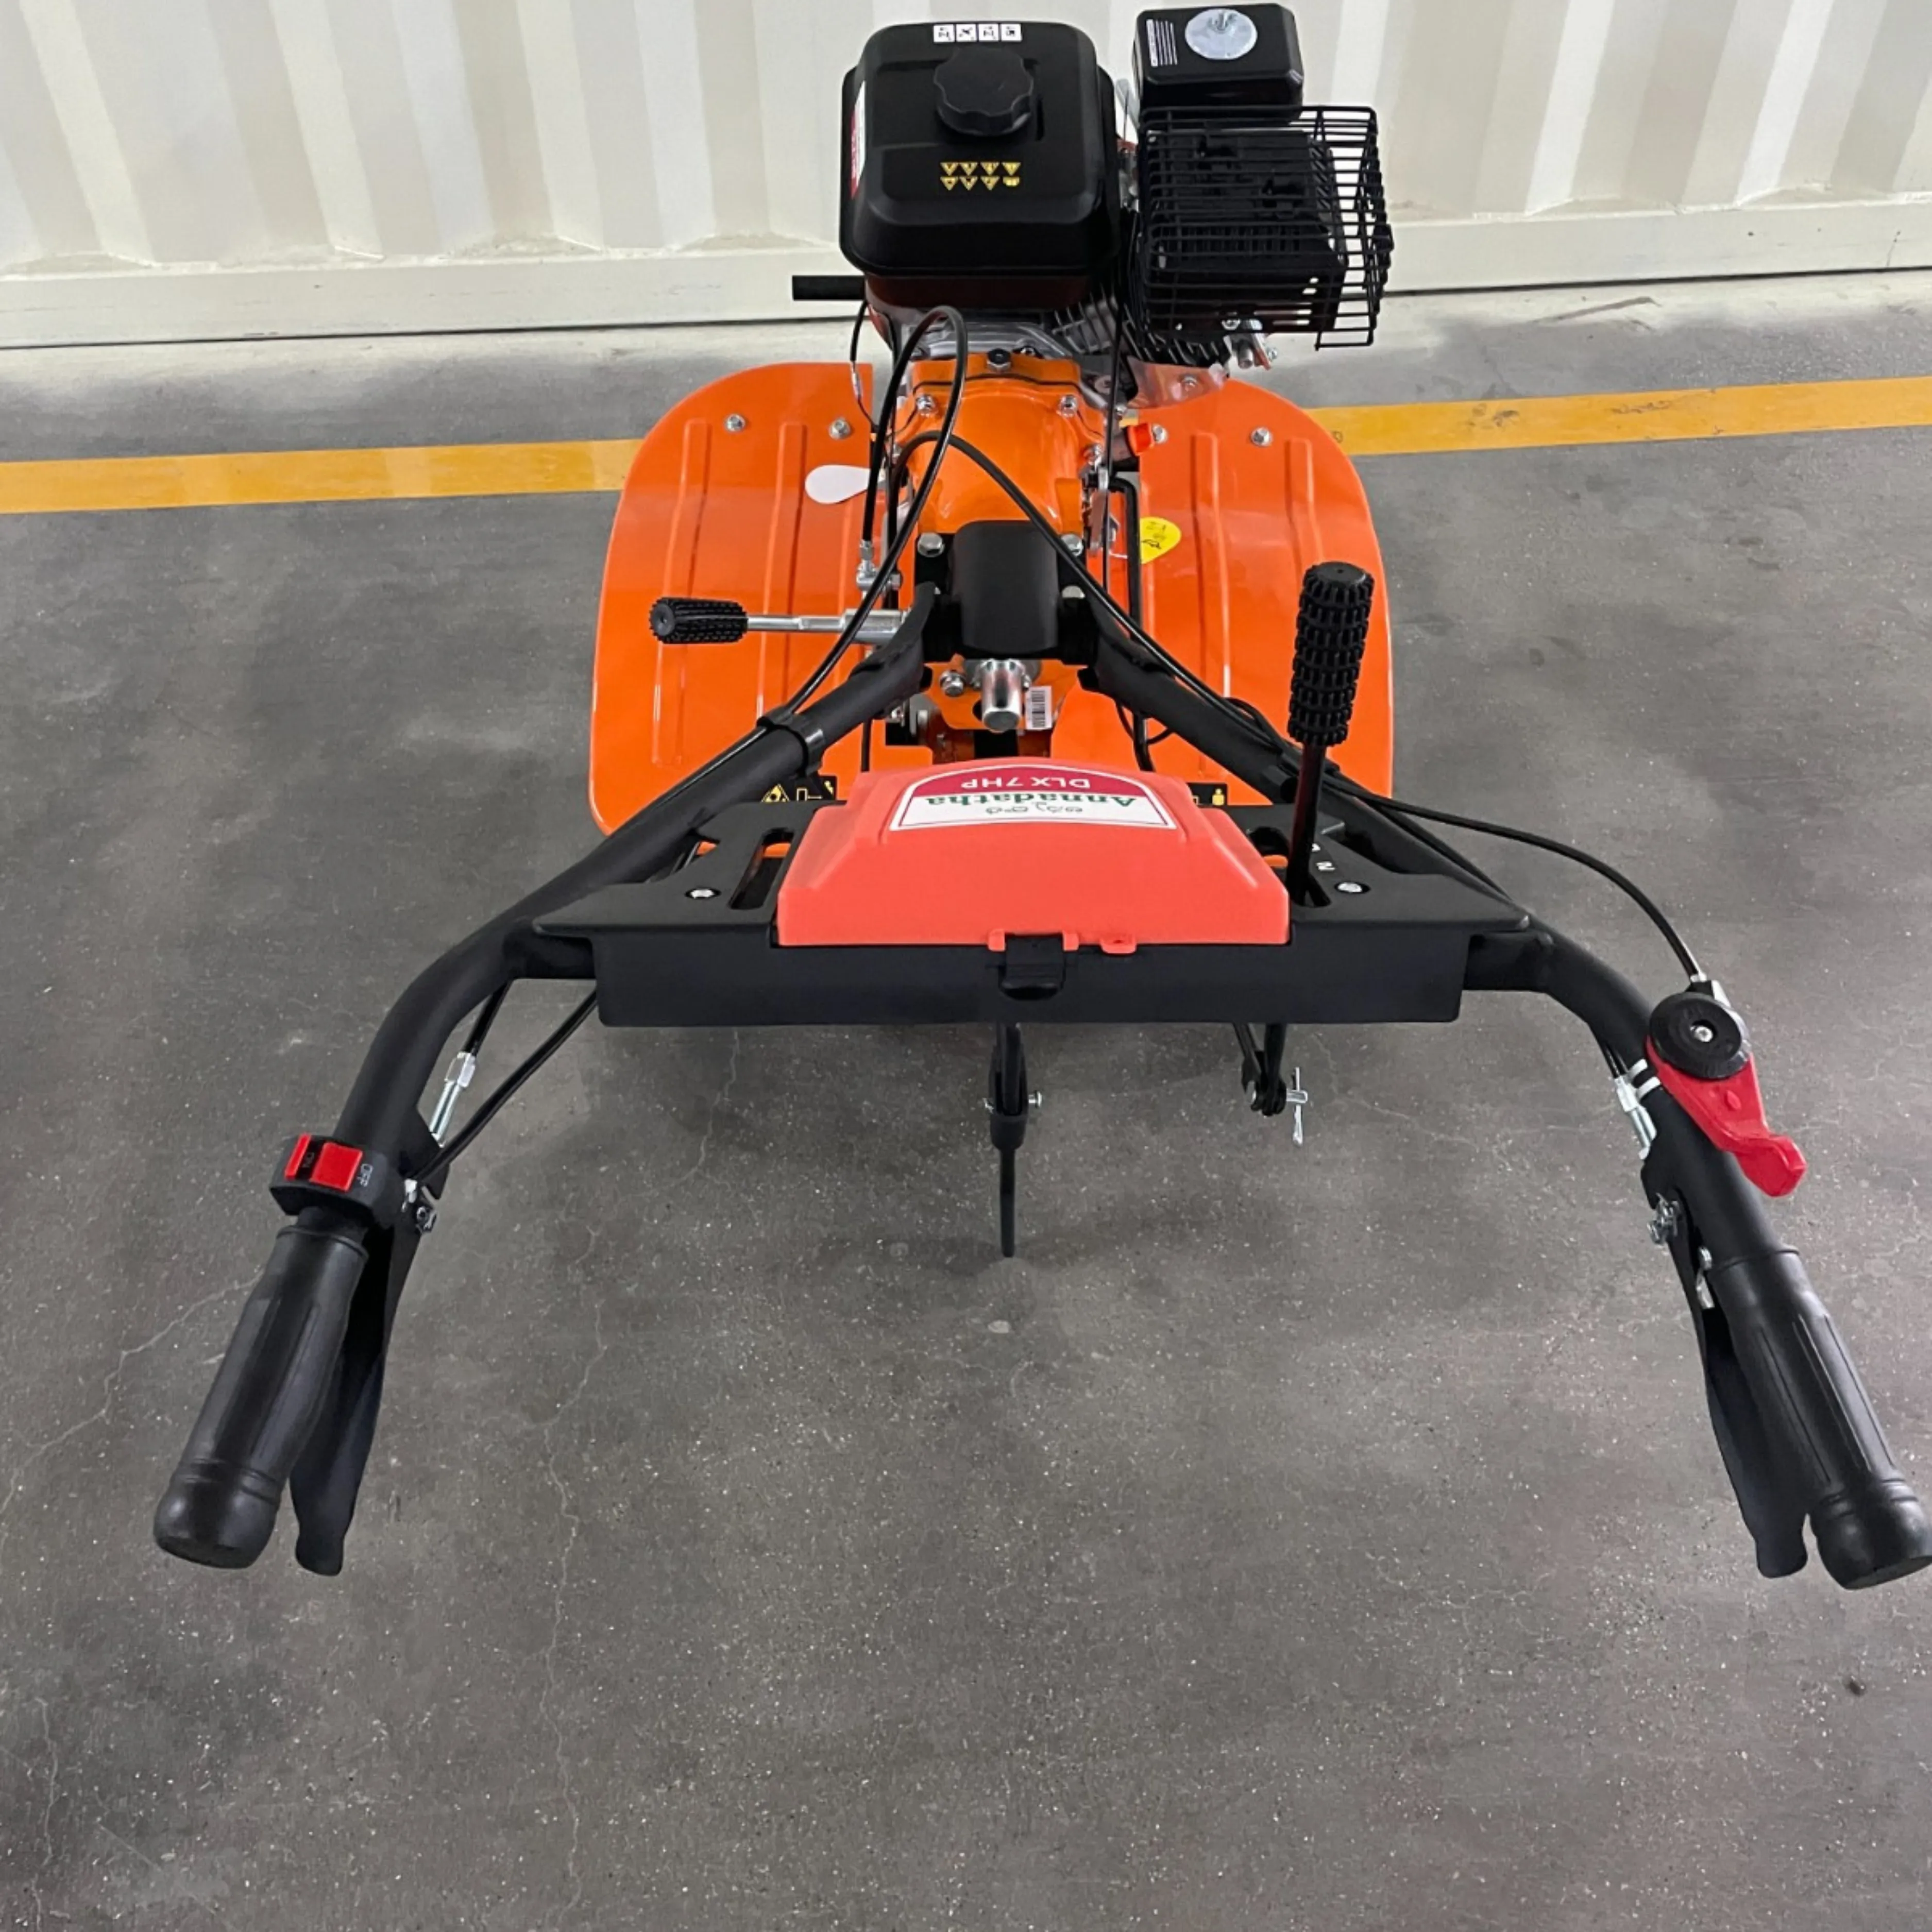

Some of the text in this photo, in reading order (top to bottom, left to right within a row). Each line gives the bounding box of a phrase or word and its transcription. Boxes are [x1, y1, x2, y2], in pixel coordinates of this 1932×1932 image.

[1032, 777, 1090, 788] DLX
[926, 794, 1137, 807] Annadatha
[357, 1163, 372, 1187] OFF
